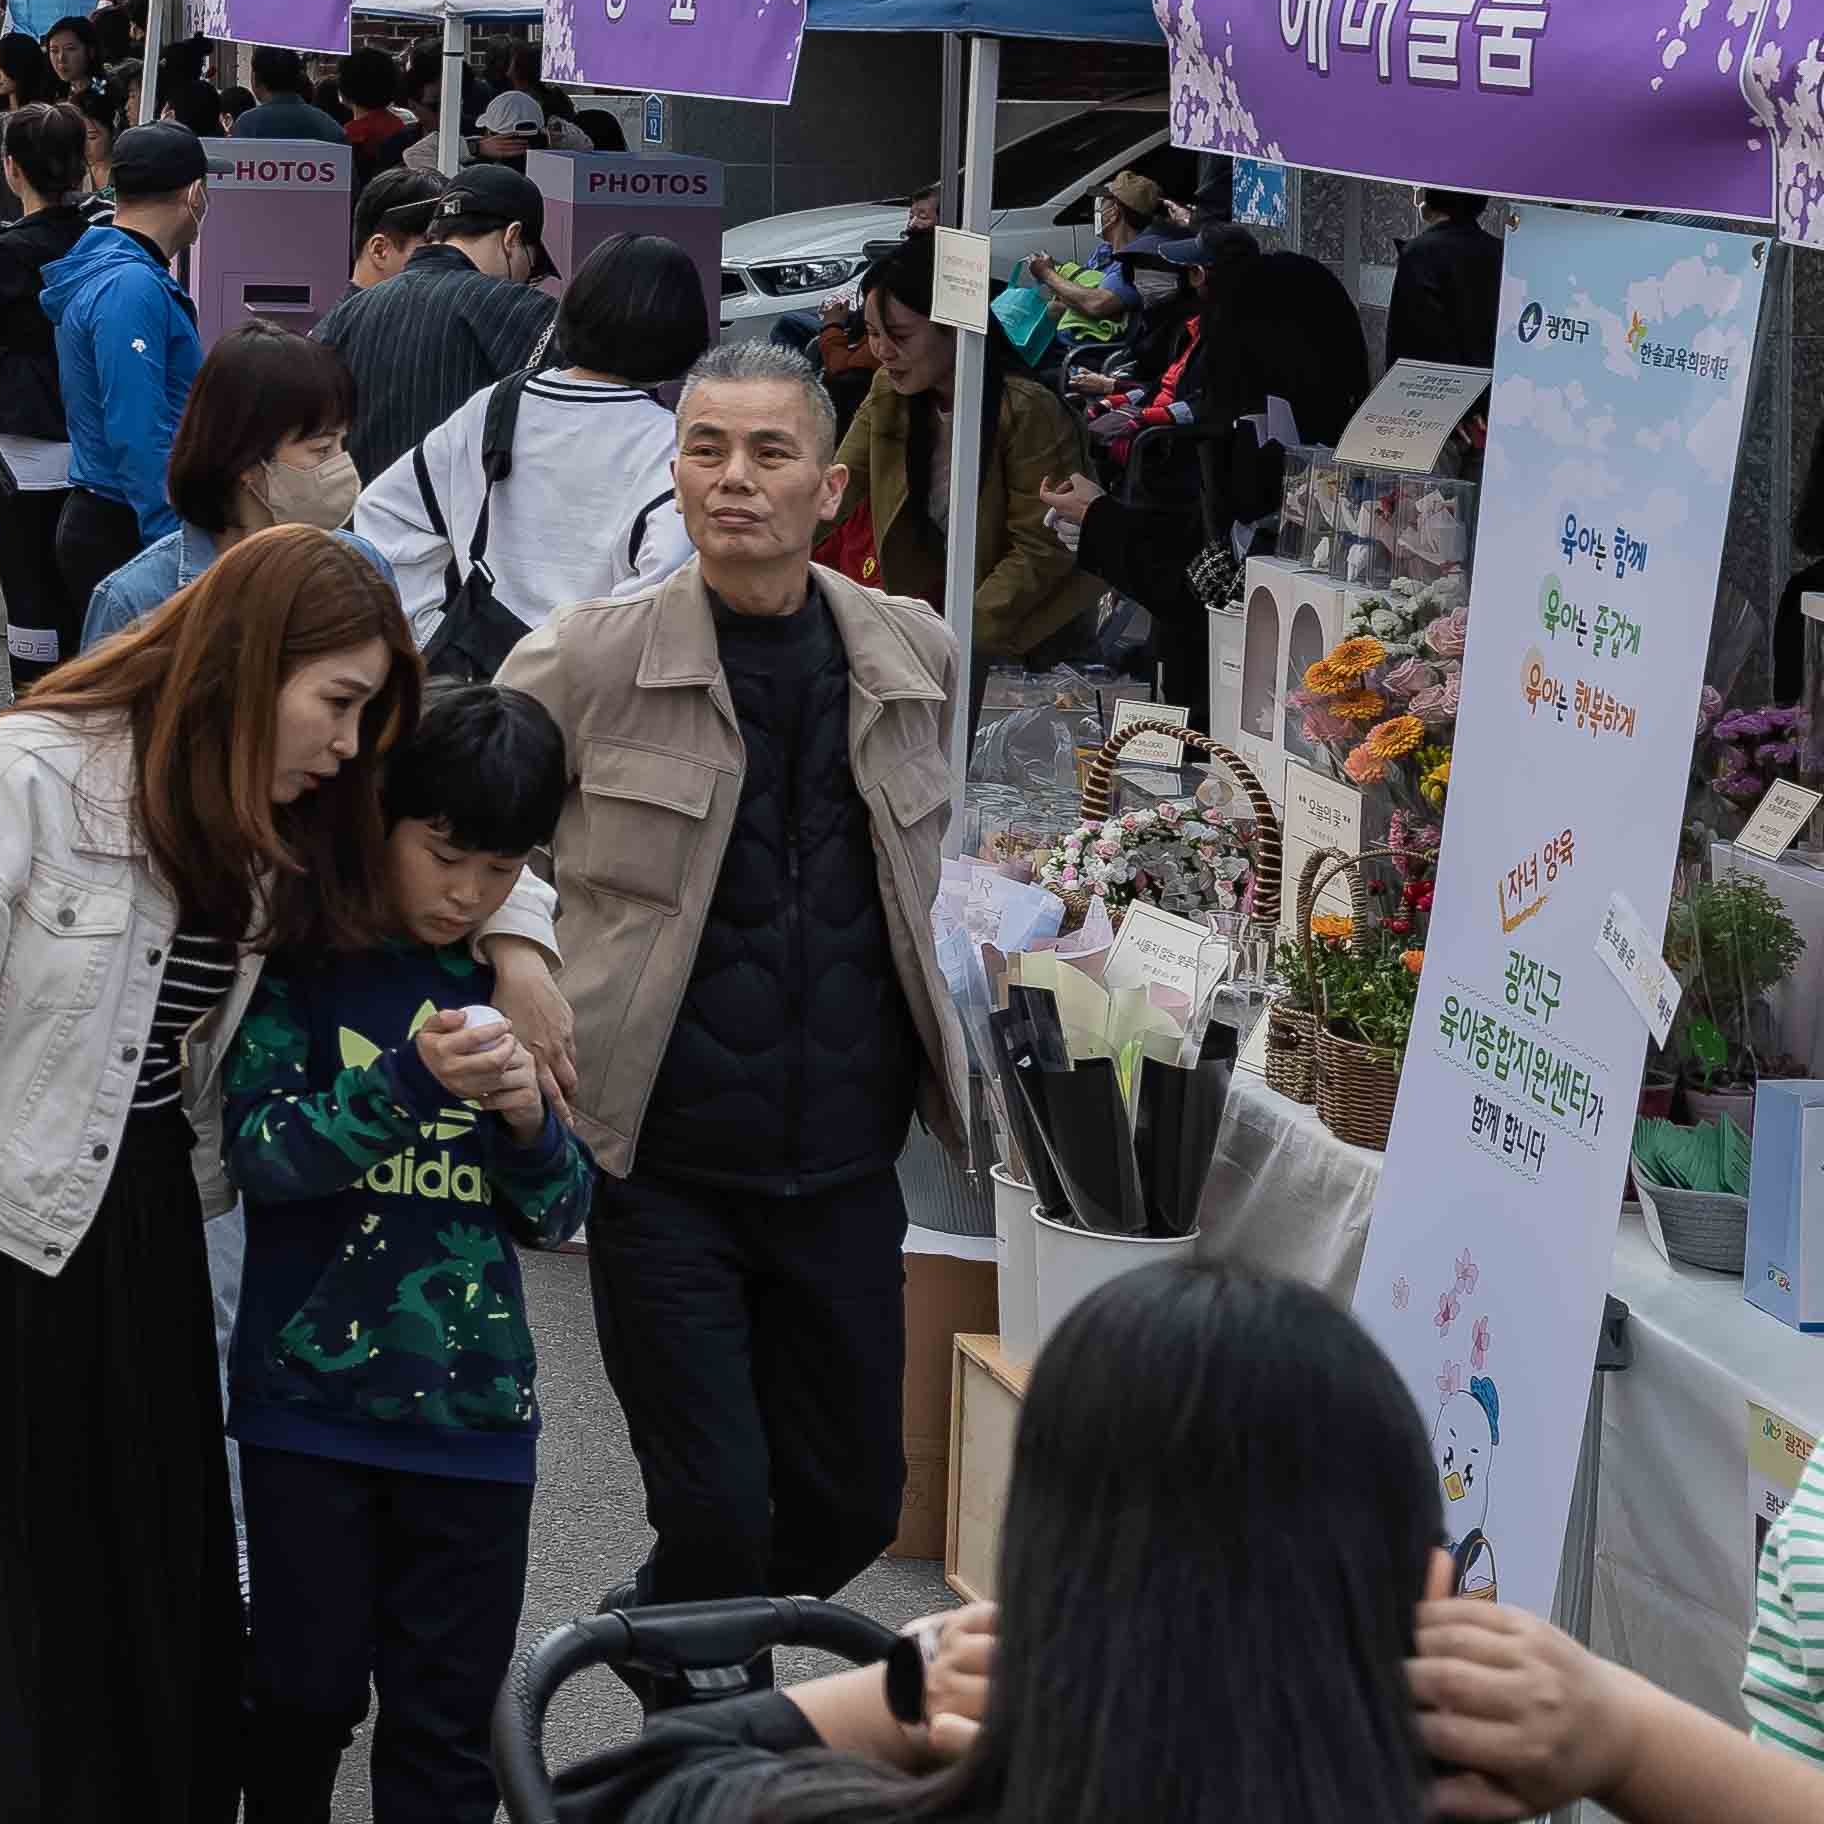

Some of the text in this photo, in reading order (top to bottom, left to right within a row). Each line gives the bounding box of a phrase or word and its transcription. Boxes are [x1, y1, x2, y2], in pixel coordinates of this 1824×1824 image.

[214, 158, 337, 184] HOTOS
[588, 170, 709, 197] PHOTOS
[1546, 314, 1590, 344] 광진구
[1560, 512, 1649, 580] 육아는 함께
[1542, 588, 1641, 660] 육아는 즐겁게
[1524, 663, 1638, 742] 육아는 행복하게
[1505, 827, 1576, 905] 자녀 양육
[1503, 949, 1563, 1026] 광진구
[1438, 993, 1605, 1138] 육아종합지원센터가
[1472, 1094, 1547, 1174] 함께 합니다
[339, 1146, 493, 1207] dida
